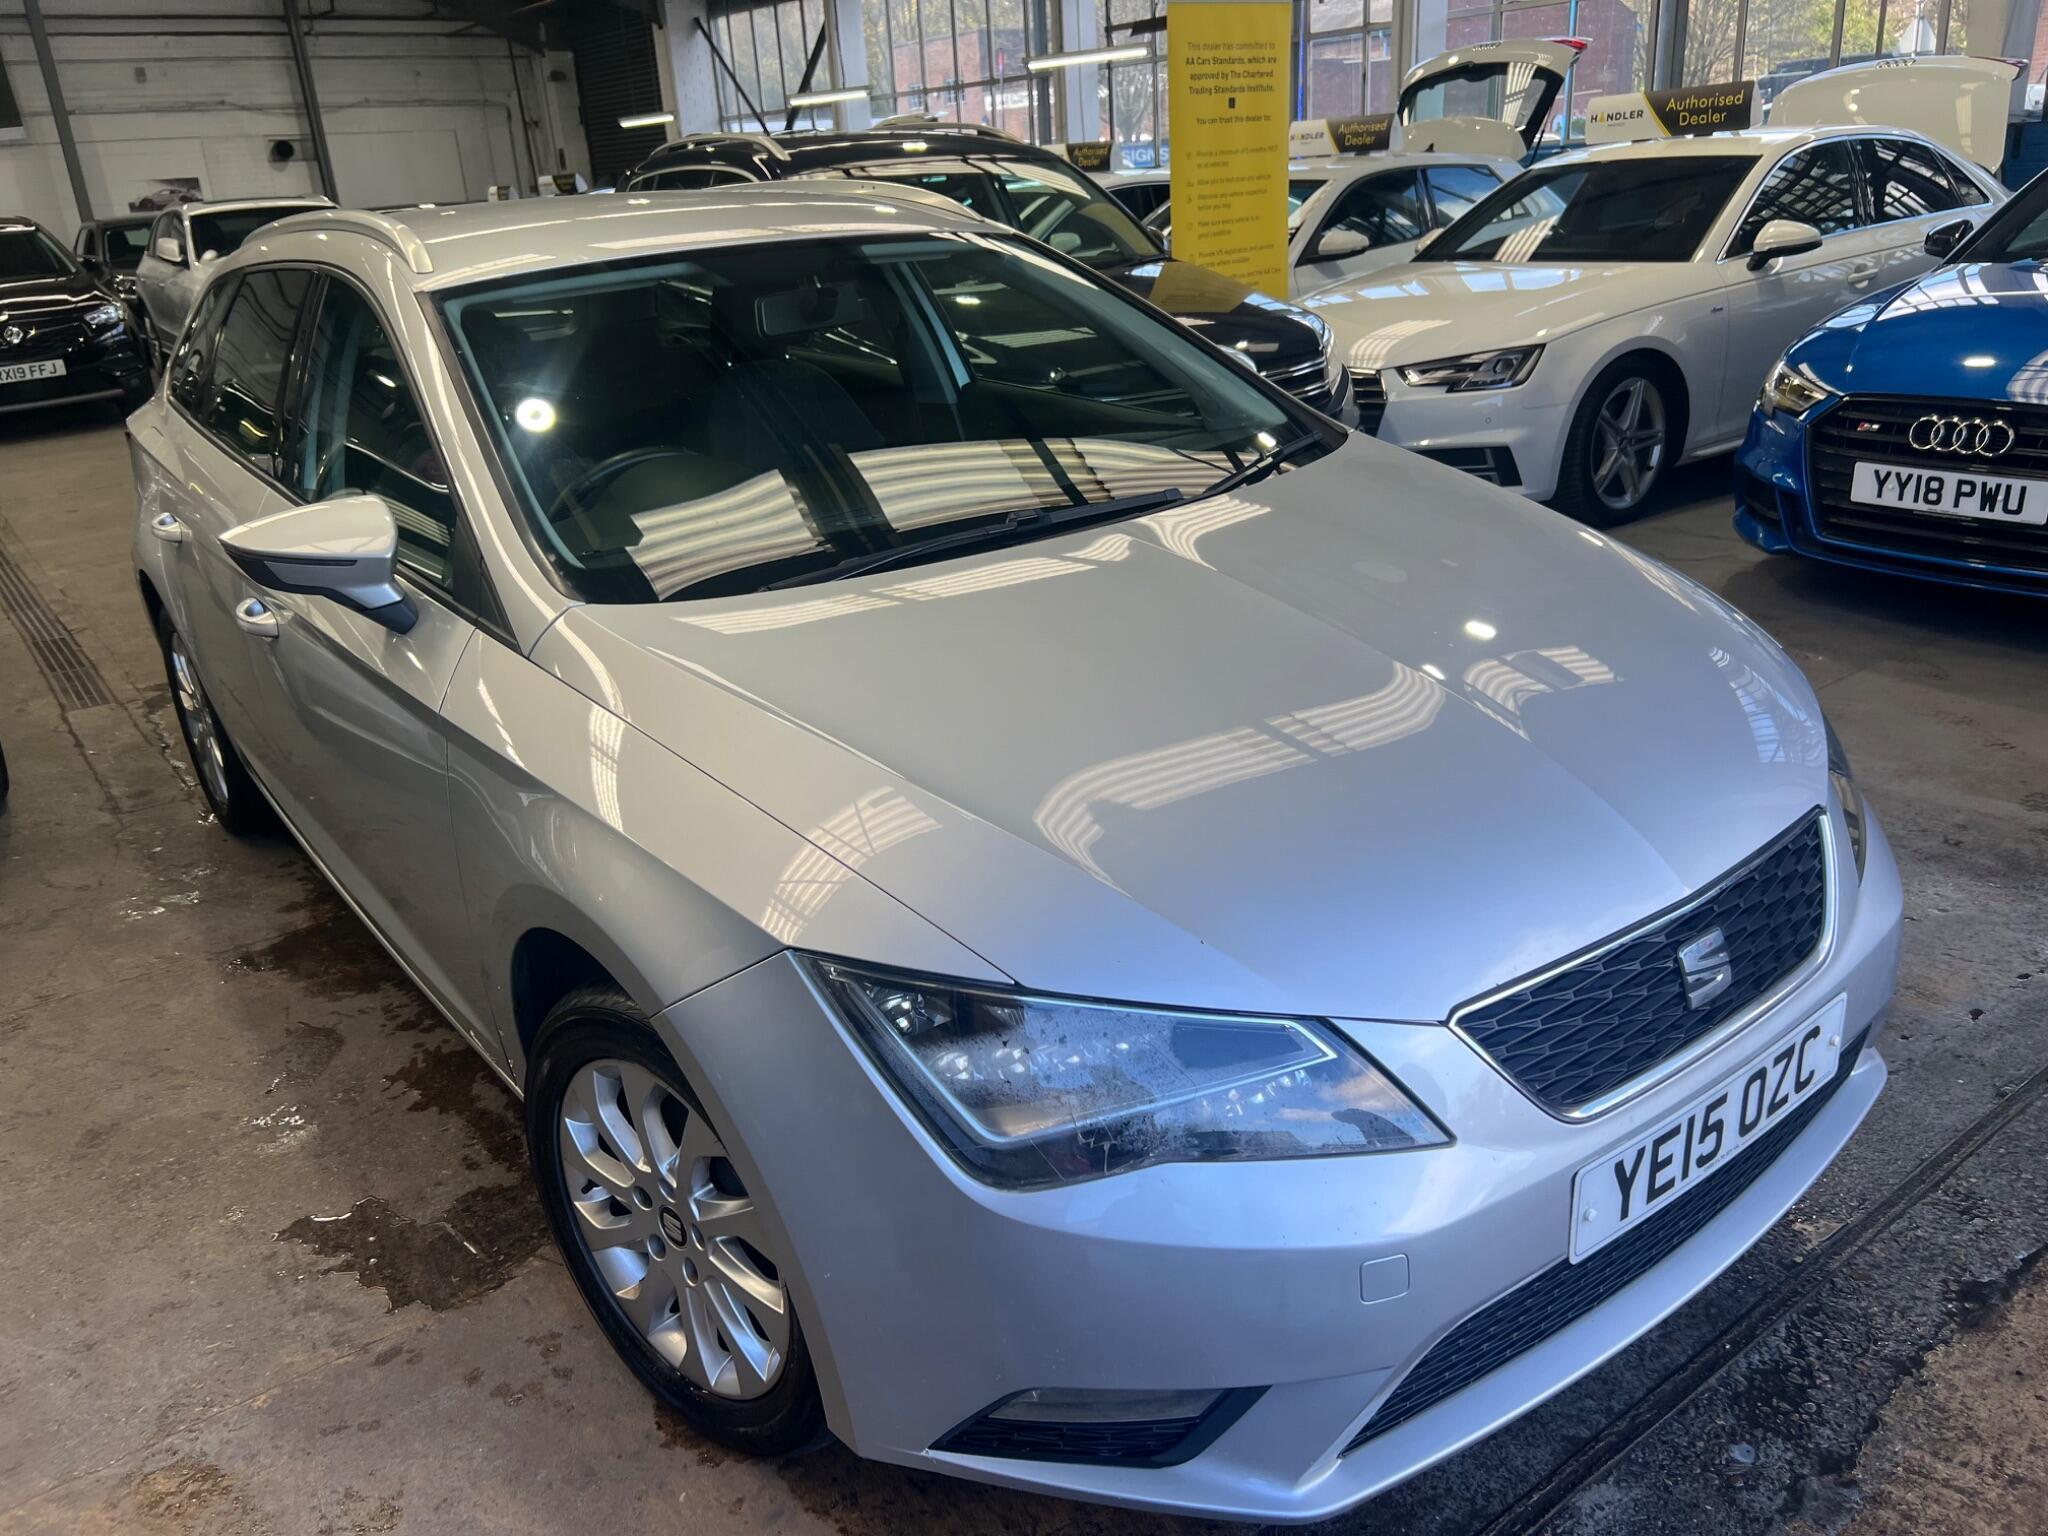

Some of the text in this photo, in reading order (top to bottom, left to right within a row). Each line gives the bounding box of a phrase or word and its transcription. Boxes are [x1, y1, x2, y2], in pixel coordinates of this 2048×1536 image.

[1202, 42, 1221, 50] dealer
[1185, 57, 1195, 65] AA
[1196, 57, 1211, 65] Cars
[1248, 56, 1265, 64] which
[1190, 70, 1274, 81] approved by The Chartered
[1189, 86, 1212, 95] Trading
[1213, 85, 1245, 94] Standards
[1666, 89, 1744, 112] Authorised
[1196, 117, 1206, 125] You
[1679, 109, 1727, 126] Dealer
[1338, 120, 1388, 134] Authorised
[1344, 133, 1376, 146] Dealer
[28, 363, 57, 377] FFJ
[1873, 469, 2027, 515] YY18 PWU
[1614, 1025, 1821, 1222] YE15 OZC
